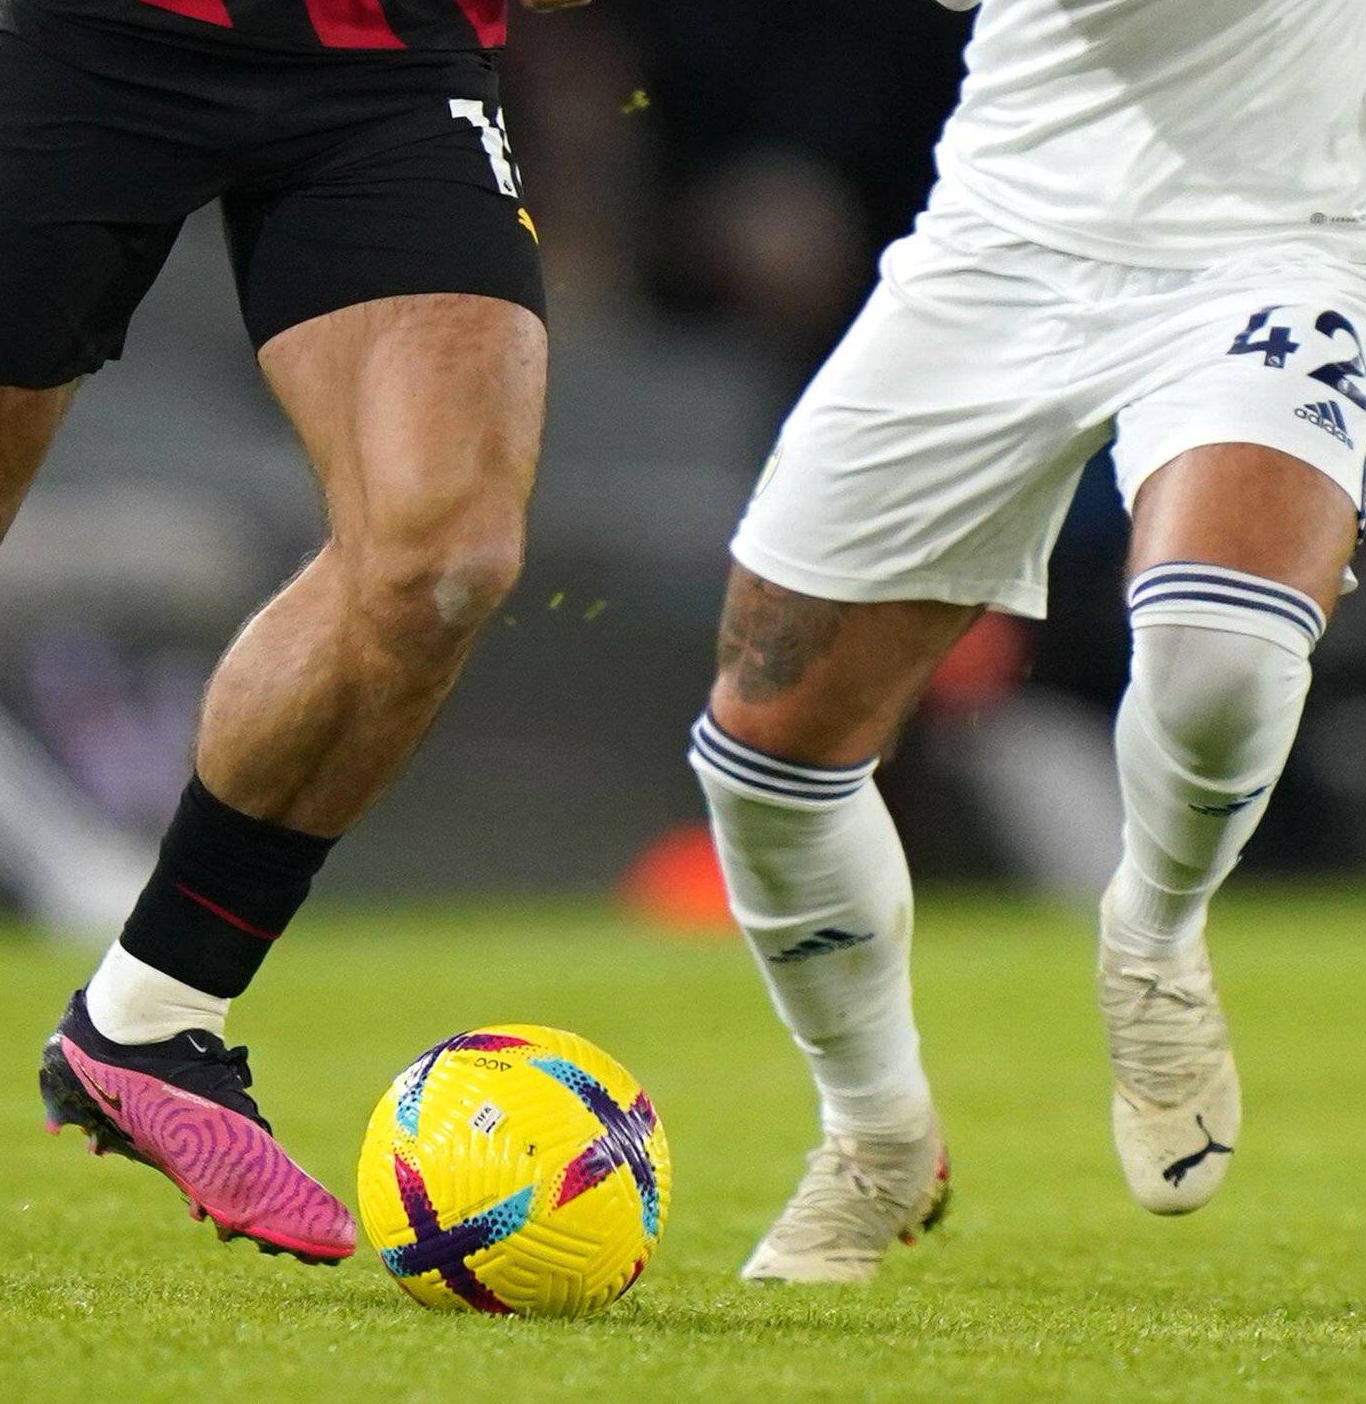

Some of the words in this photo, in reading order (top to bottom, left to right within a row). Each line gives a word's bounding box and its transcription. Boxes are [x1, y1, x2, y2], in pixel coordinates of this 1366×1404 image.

[448, 98, 524, 199] 1
[1294, 406, 1355, 451] adidas
[473, 1106, 492, 1128] FIFA
